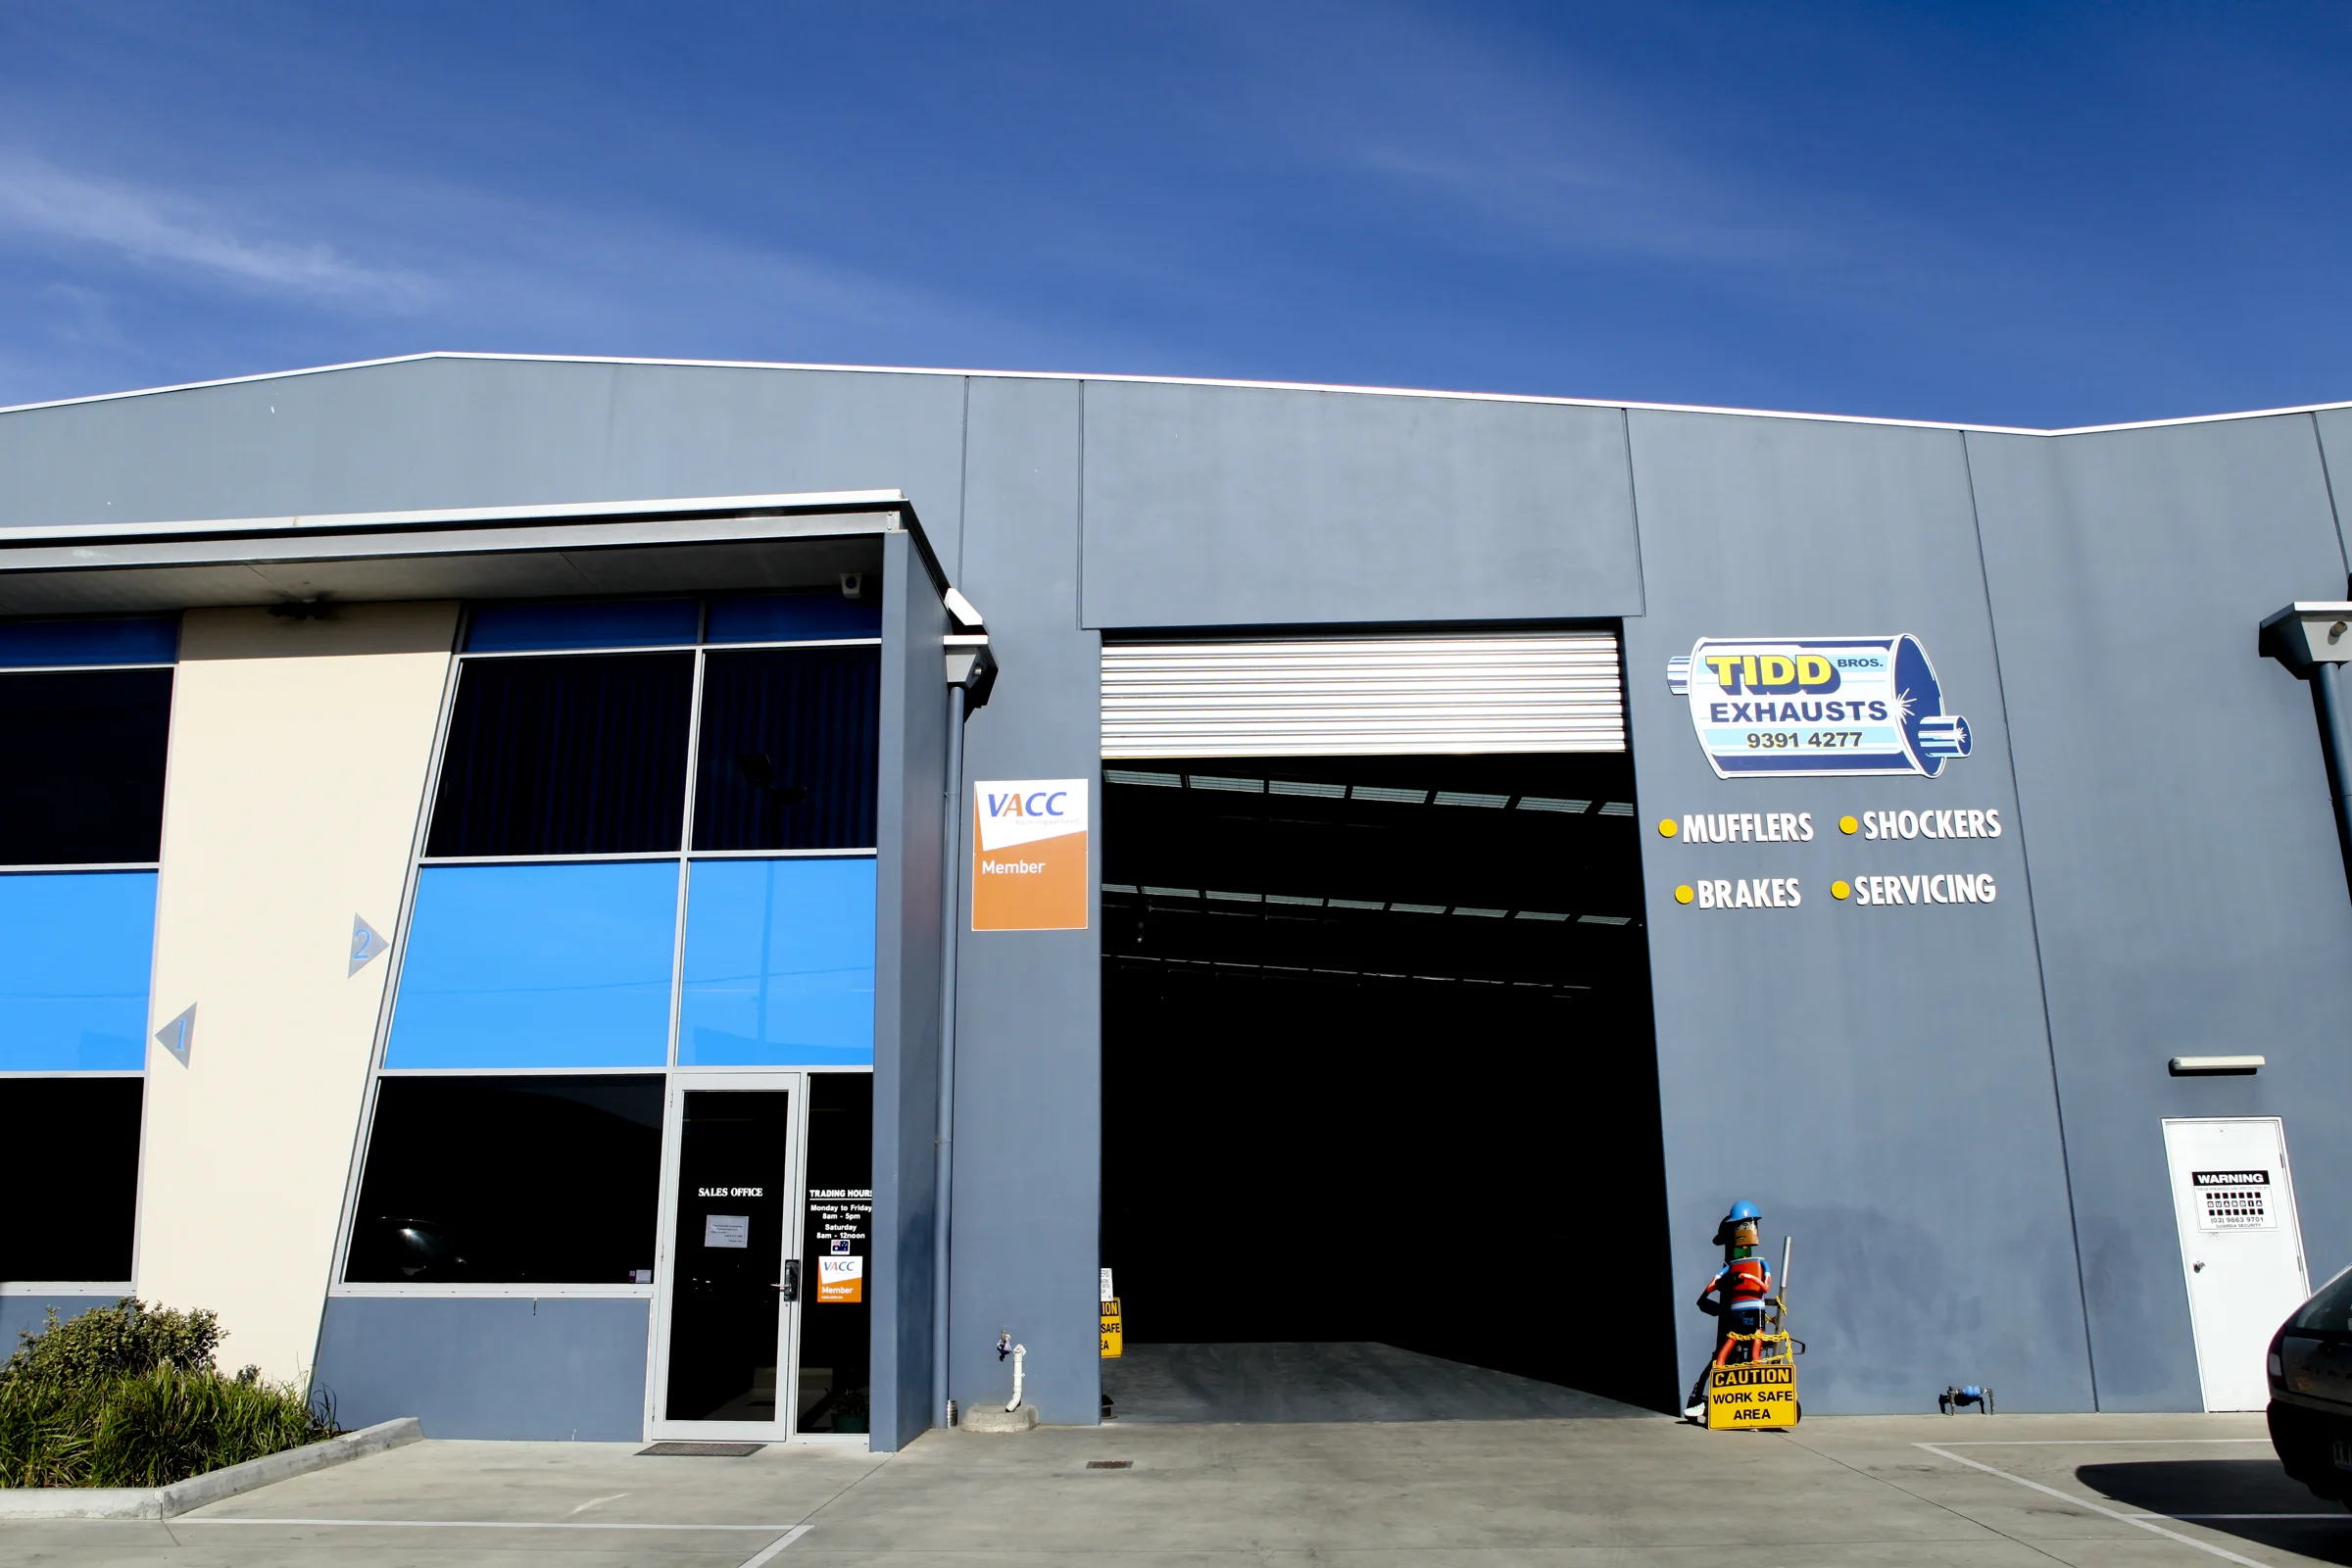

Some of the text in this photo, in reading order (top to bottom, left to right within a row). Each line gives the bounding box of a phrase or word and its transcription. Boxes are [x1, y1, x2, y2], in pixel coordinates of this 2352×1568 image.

[1837, 659, 1884, 668] BROS.
[1705, 655, 1837, 691] TIDD
[1709, 701, 1888, 723] EXHAUSTS
[1746, 732, 1863, 749] 9391 4277
[988, 792, 1067, 817] VACC
[1683, 812, 1814, 843] MUFFLERS
[1863, 809, 2002, 840] SHOCKERS
[982, 859, 1046, 874] Member
[1697, 878, 1801, 908] BRAKES
[1854, 873, 1996, 906] SERVICING
[353, 930, 370, 959] 2
[2197, 1174, 2264, 1184] WARNING
[698, 1188, 763, 1197] SALES OFFICE
[845, 1212, 860, 1221] 5pm
[824, 1261, 855, 1272] VACC
[1101, 1323, 1120, 1334] SAFE
[1715, 1369, 1789, 1386] CAUTION
[1713, 1391, 1793, 1404] WORK SAFE
[1734, 1409, 1771, 1421] AREA
